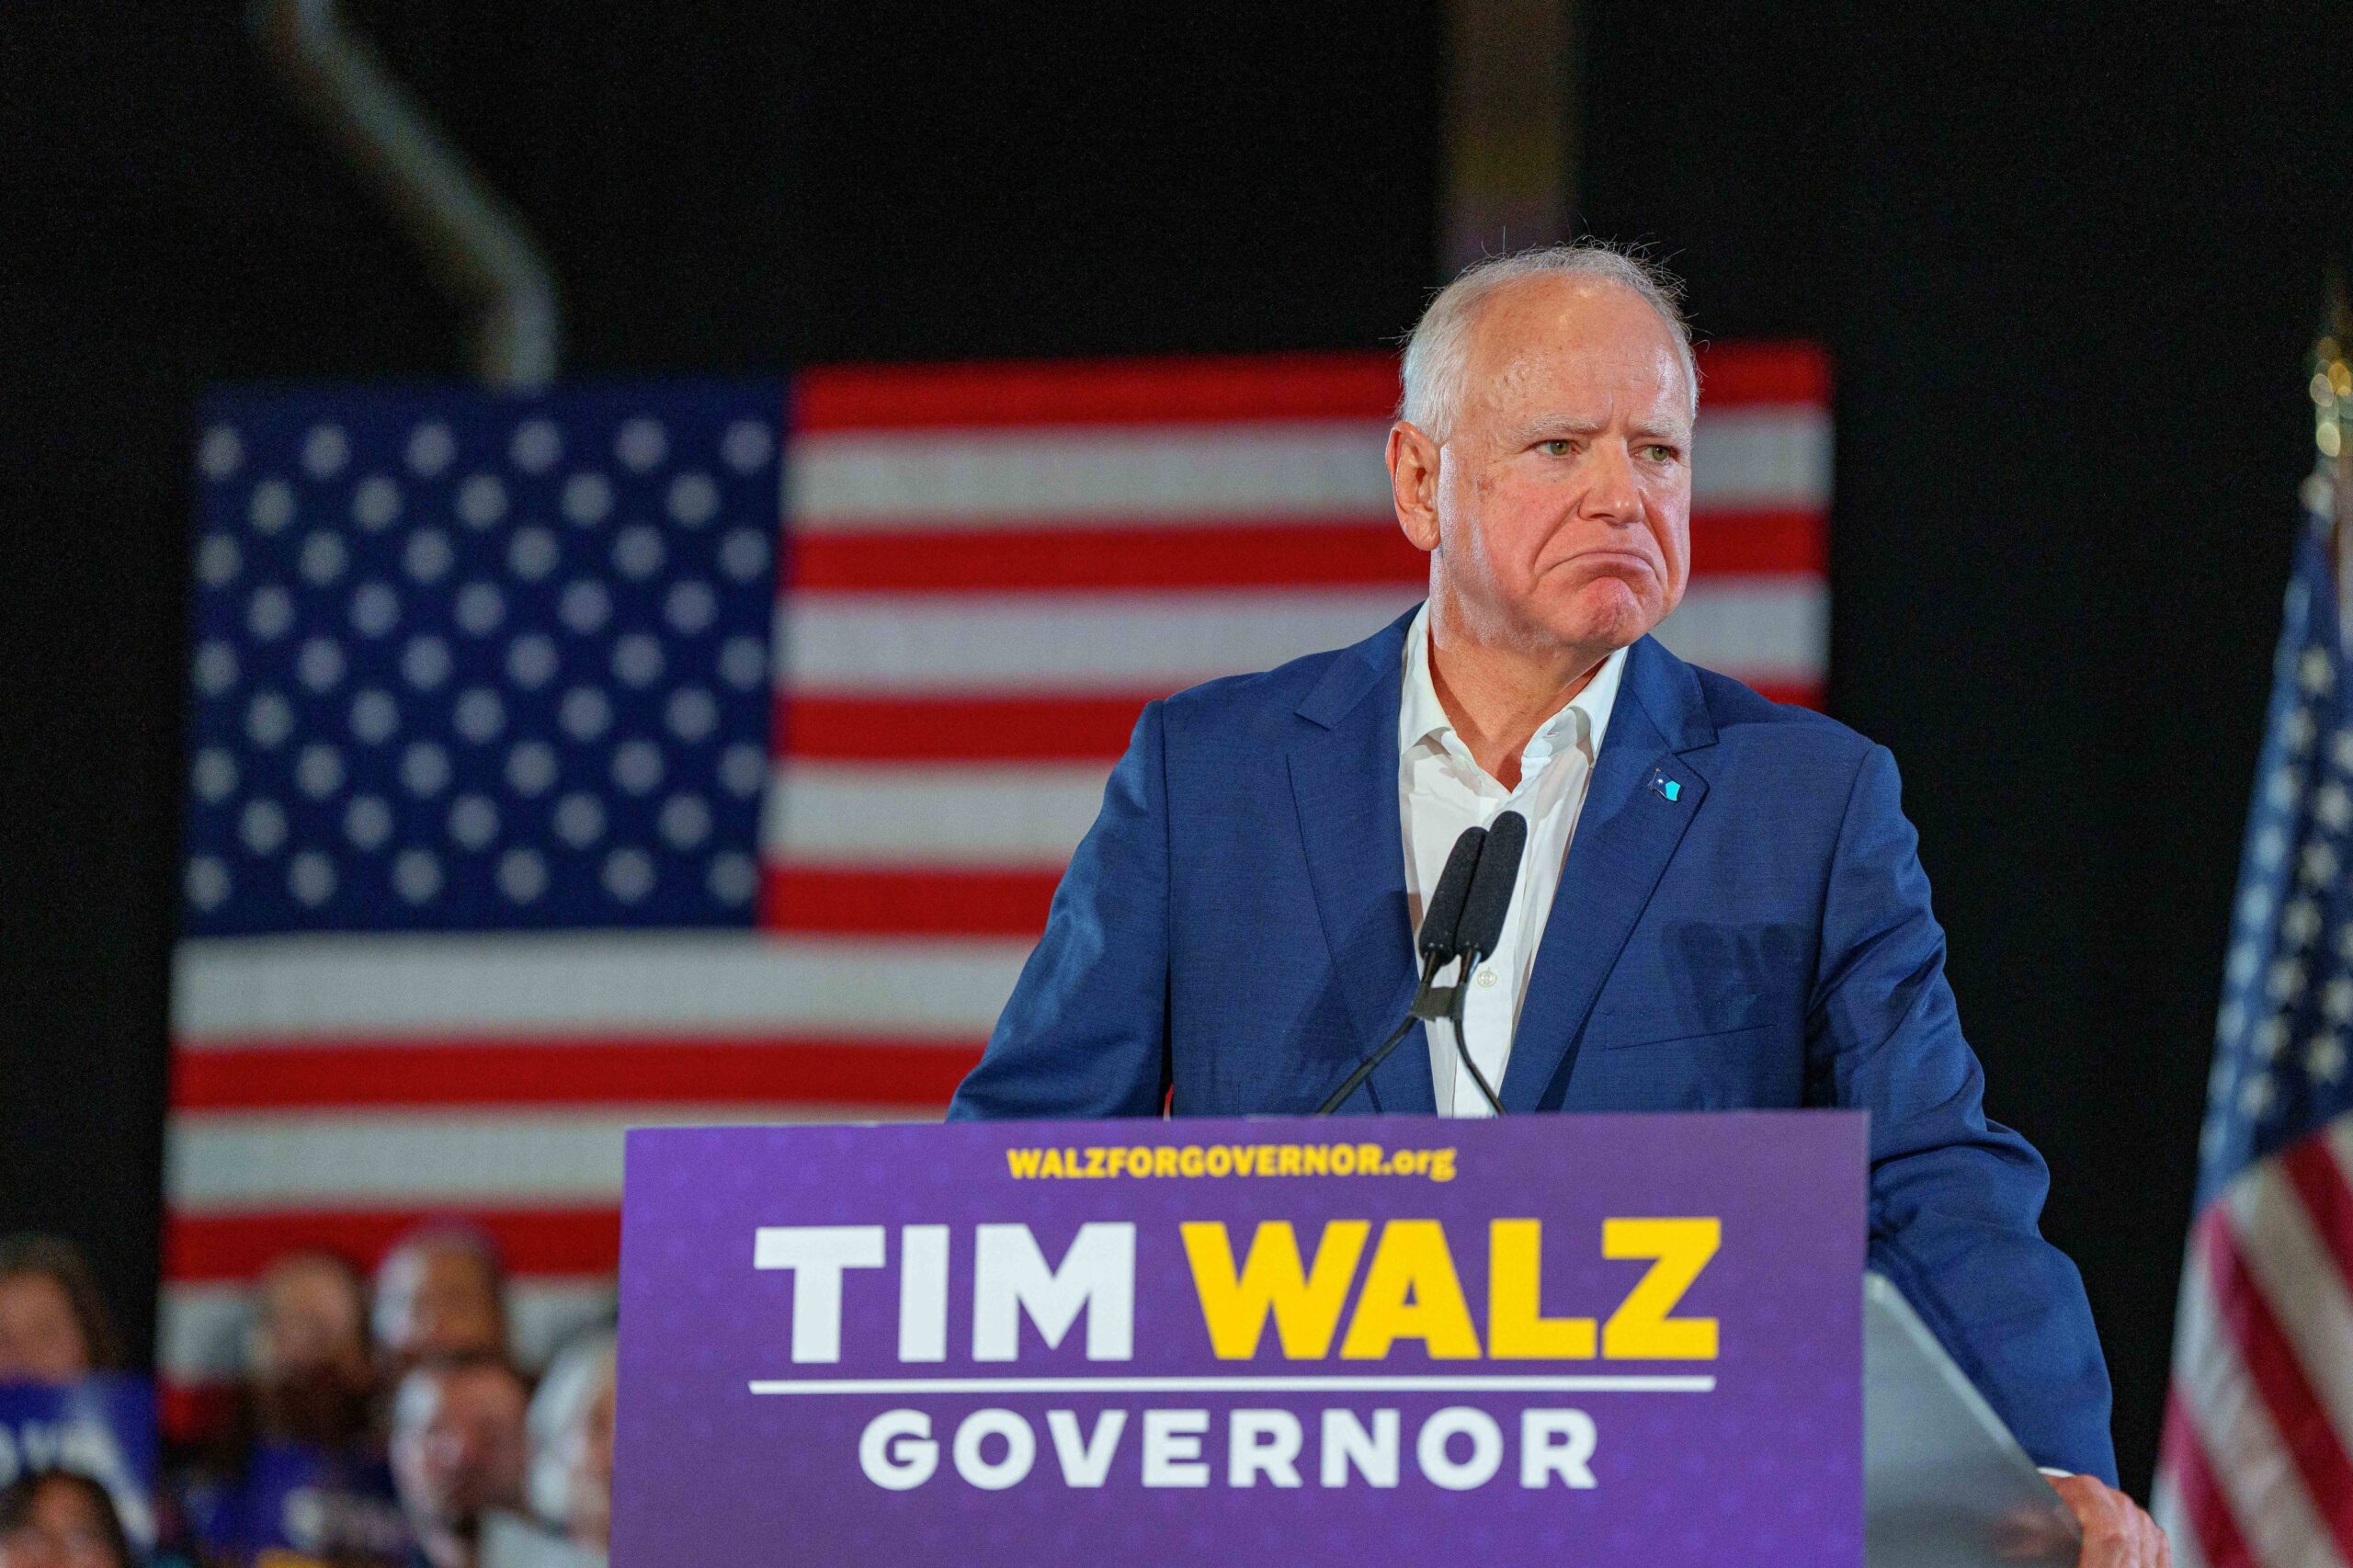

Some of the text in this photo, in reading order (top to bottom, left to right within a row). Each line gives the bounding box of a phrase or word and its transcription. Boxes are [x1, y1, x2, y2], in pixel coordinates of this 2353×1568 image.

[1006, 1143, 1457, 1182] WALZFORGOVERNOR.org
[754, 1218, 1721, 1363] TIM WALZ
[859, 1407, 1597, 1490] GOVERNOR
